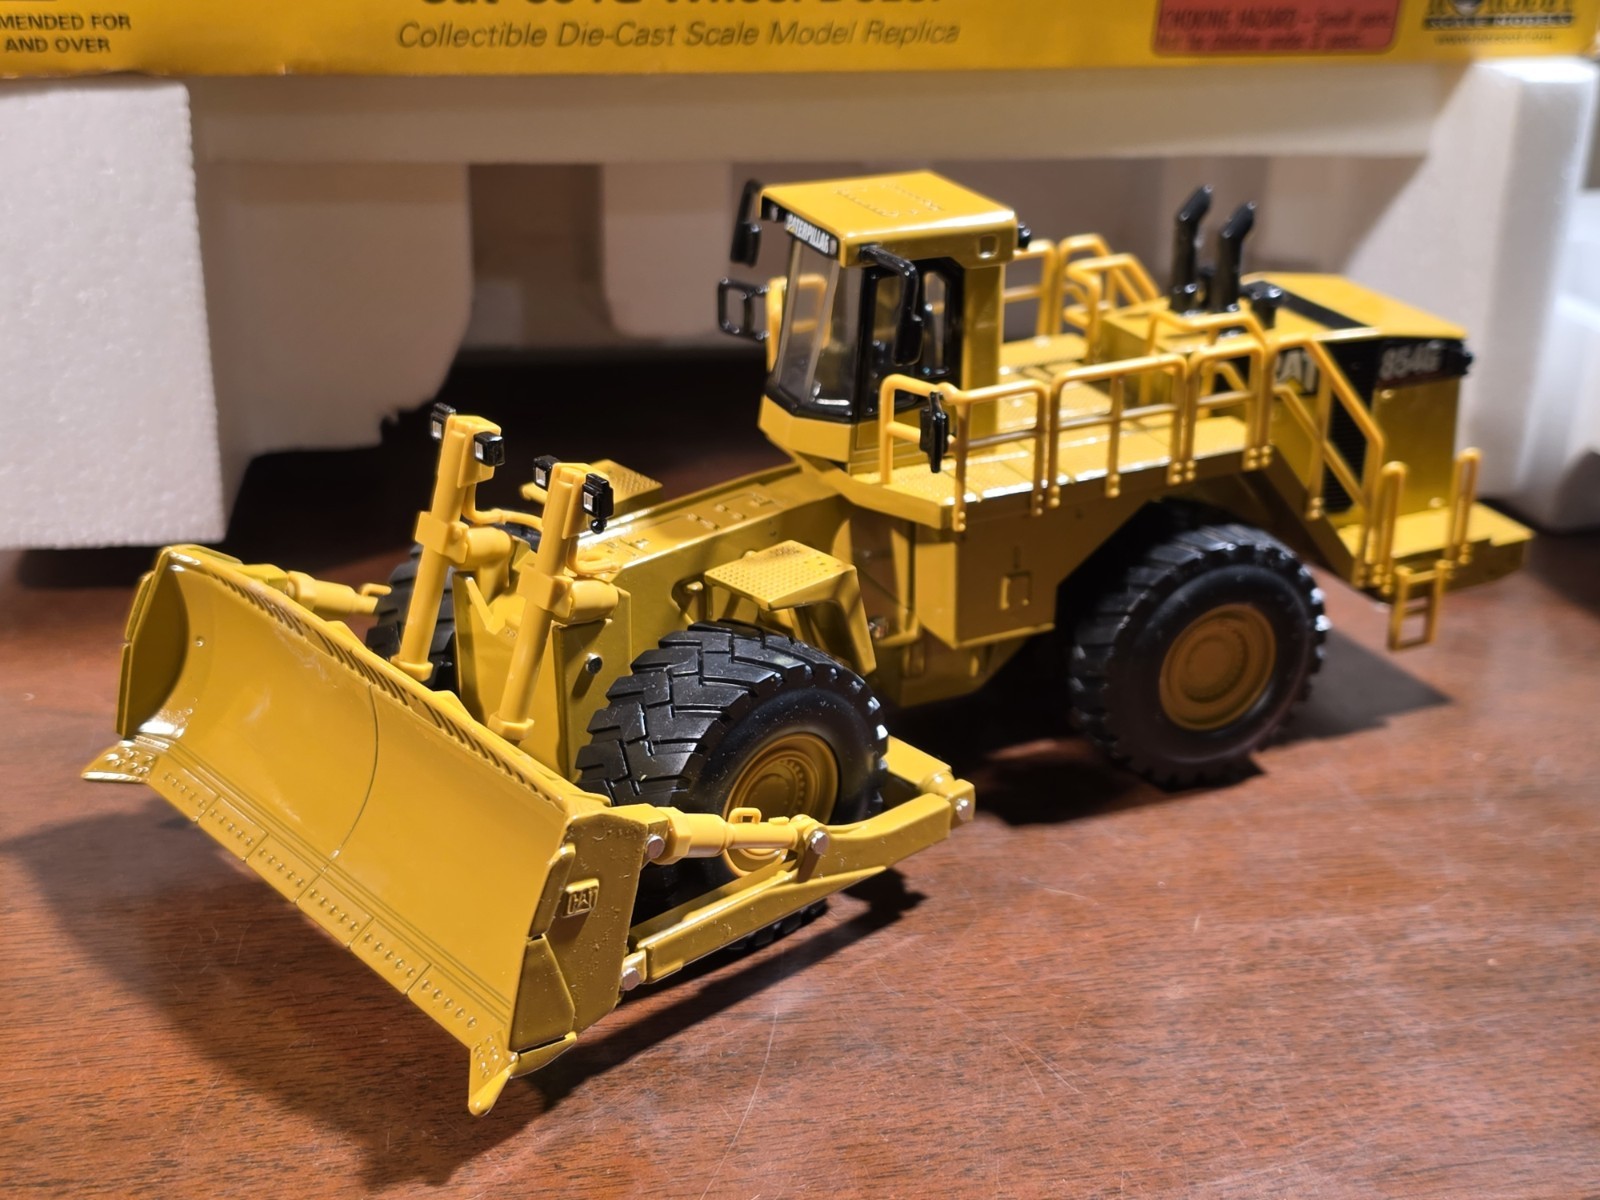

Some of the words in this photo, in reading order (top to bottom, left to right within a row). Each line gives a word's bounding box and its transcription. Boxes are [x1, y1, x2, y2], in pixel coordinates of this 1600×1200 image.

[91, 14, 131, 31] FOR
[399, 21, 548, 48] Collectible
[556, 20, 678, 48] Die-Cast
[684, 20, 760, 47] Scale
[769, 19, 858, 46] Model
[863, 18, 962, 49] Replica
[4, 36, 49, 53] AND
[54, 36, 112, 53] OVER
